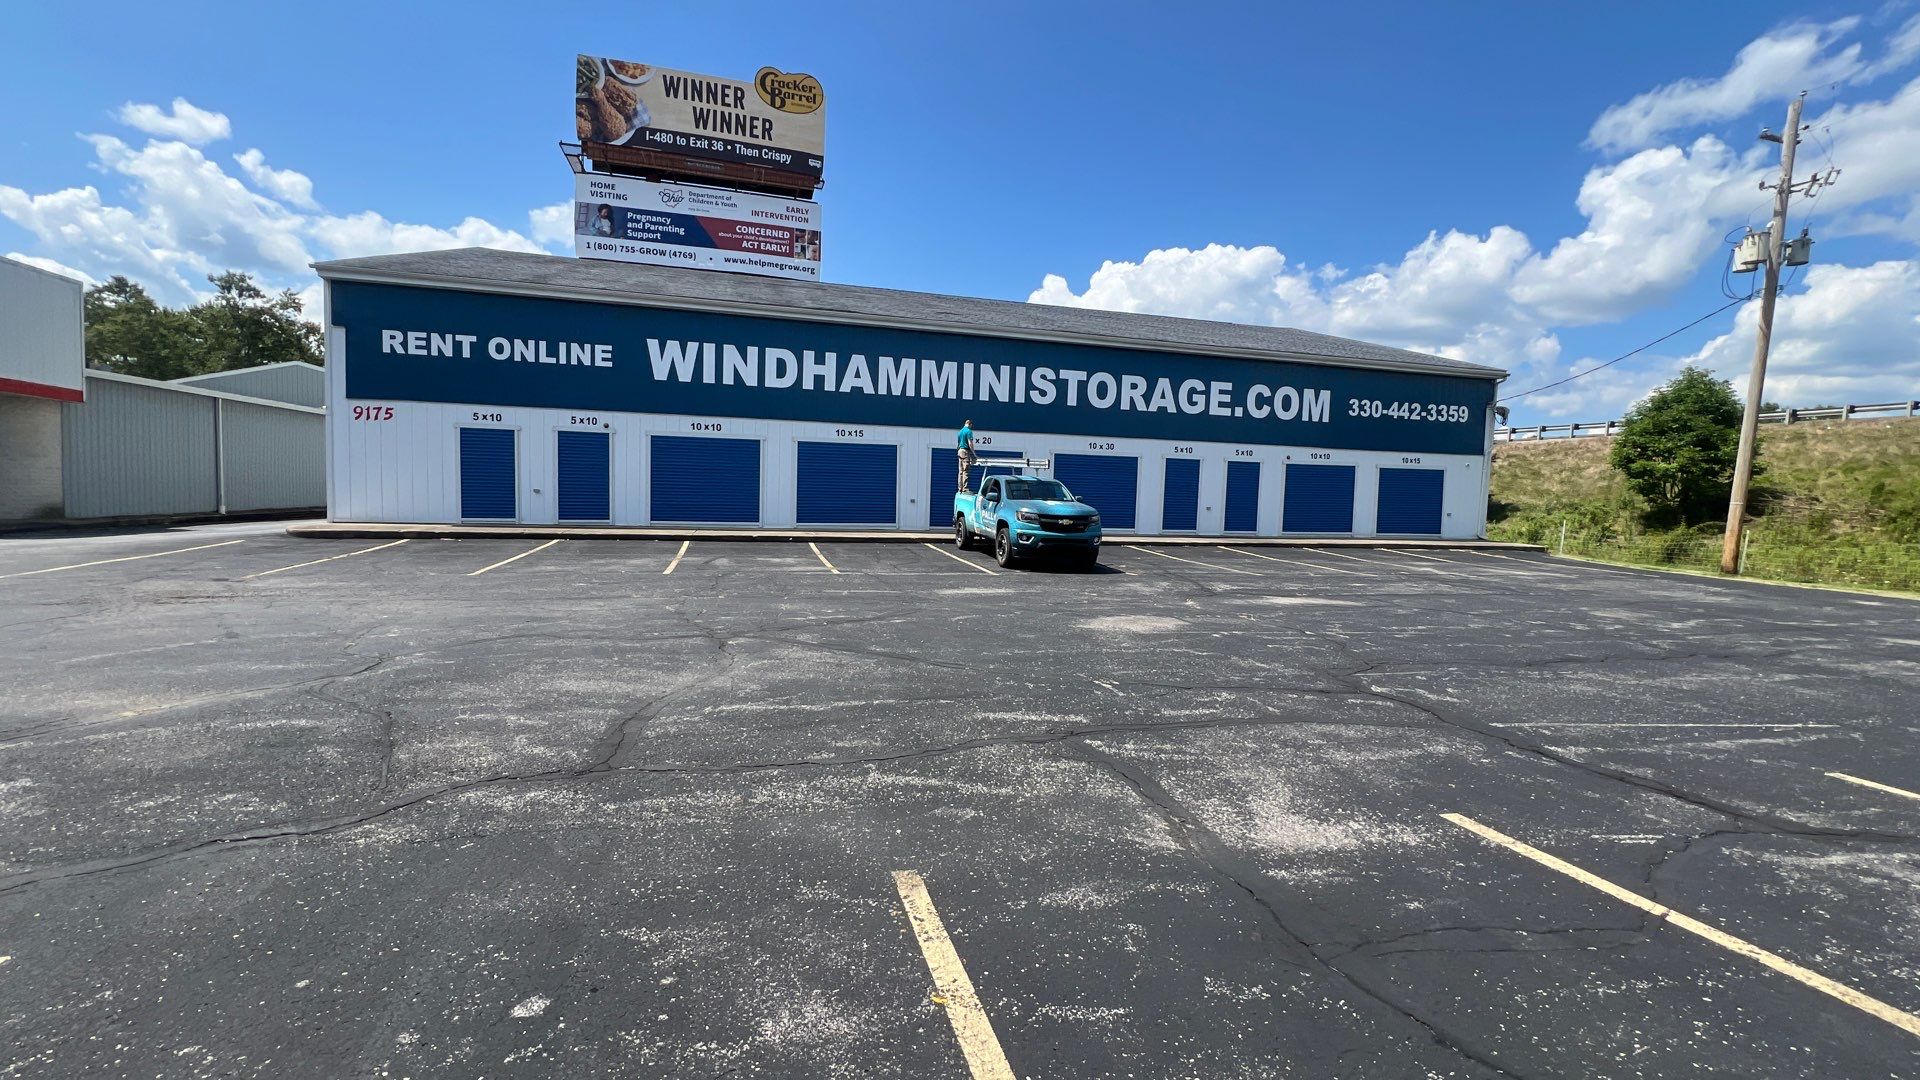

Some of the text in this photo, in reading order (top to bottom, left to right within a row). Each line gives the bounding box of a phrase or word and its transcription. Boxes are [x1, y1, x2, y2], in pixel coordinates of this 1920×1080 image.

[760, 72, 816, 94] Cracker
[663, 74, 745, 110] WINNER
[770, 88, 816, 109] Barrel
[693, 107, 773, 141] WINNER
[646, 131, 791, 164] I-480 to Exit 36 Then Crispy
[590, 181, 616, 190] HOME
[590, 190, 628, 201] VISITING
[658, 190, 685, 203] Ohio
[689, 191, 724, 201] Department
[689, 198, 713, 206] Children
[751, 210, 809, 223] INTERVENTION
[786, 206, 810, 215] EARLY
[627, 212, 672, 225] Pregnancy
[627, 221, 685, 235] and Parenting
[736, 225, 790, 239] CONCERNED
[627, 230, 661, 240] Support
[742, 241, 790, 253] ACT EARLY!
[594, 242, 617, 253] (800)
[620, 245, 667, 257] 755-GROW
[669, 249, 697, 261] (4769)
[724, 256, 816, 275] www.helpmegrow.org
[381, 329, 613, 368] RENT ONLINE
[646, 338, 1331, 424] WINDHAMMINISTORAGE.COM
[353, 405, 394, 421] 9175
[1348, 398, 1469, 423] 330-442-3359
[473, 413, 479, 421] 5
[489, 413, 502, 422] 10
[571, 416, 576, 425] 5
[585, 417, 598, 426] 10
[690, 423, 701, 431] 10
[710, 423, 722, 432] 10
[835, 429, 846, 437] 10
[853, 429, 863, 438] 15
[982, 437, 992, 445] 20
